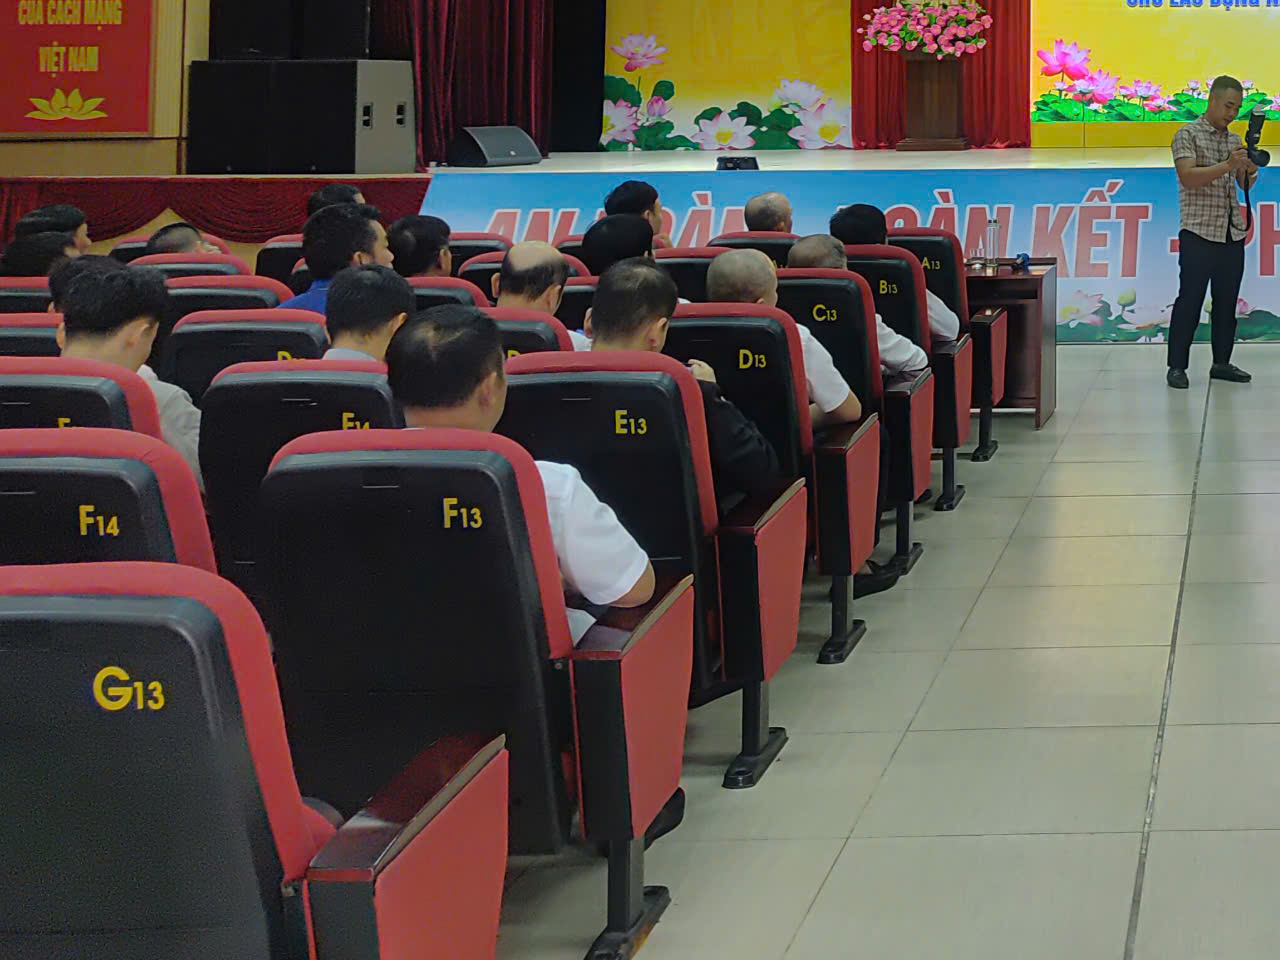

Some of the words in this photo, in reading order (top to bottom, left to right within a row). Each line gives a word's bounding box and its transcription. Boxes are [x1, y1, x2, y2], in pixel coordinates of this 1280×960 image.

[39, 40, 66, 78] VIỆT
[68, 45, 99, 72] NAM
[1031, 179, 1150, 278] KẾT
[922, 256, 941, 270] A13
[879, 279, 898, 295] B13
[812, 303, 838, 322] C13
[738, 348, 767, 370] D13
[615, 409, 648, 436] E13
[78, 504, 120, 537] F14
[442, 497, 483, 529] F13
[92, 665, 165, 711] G13
